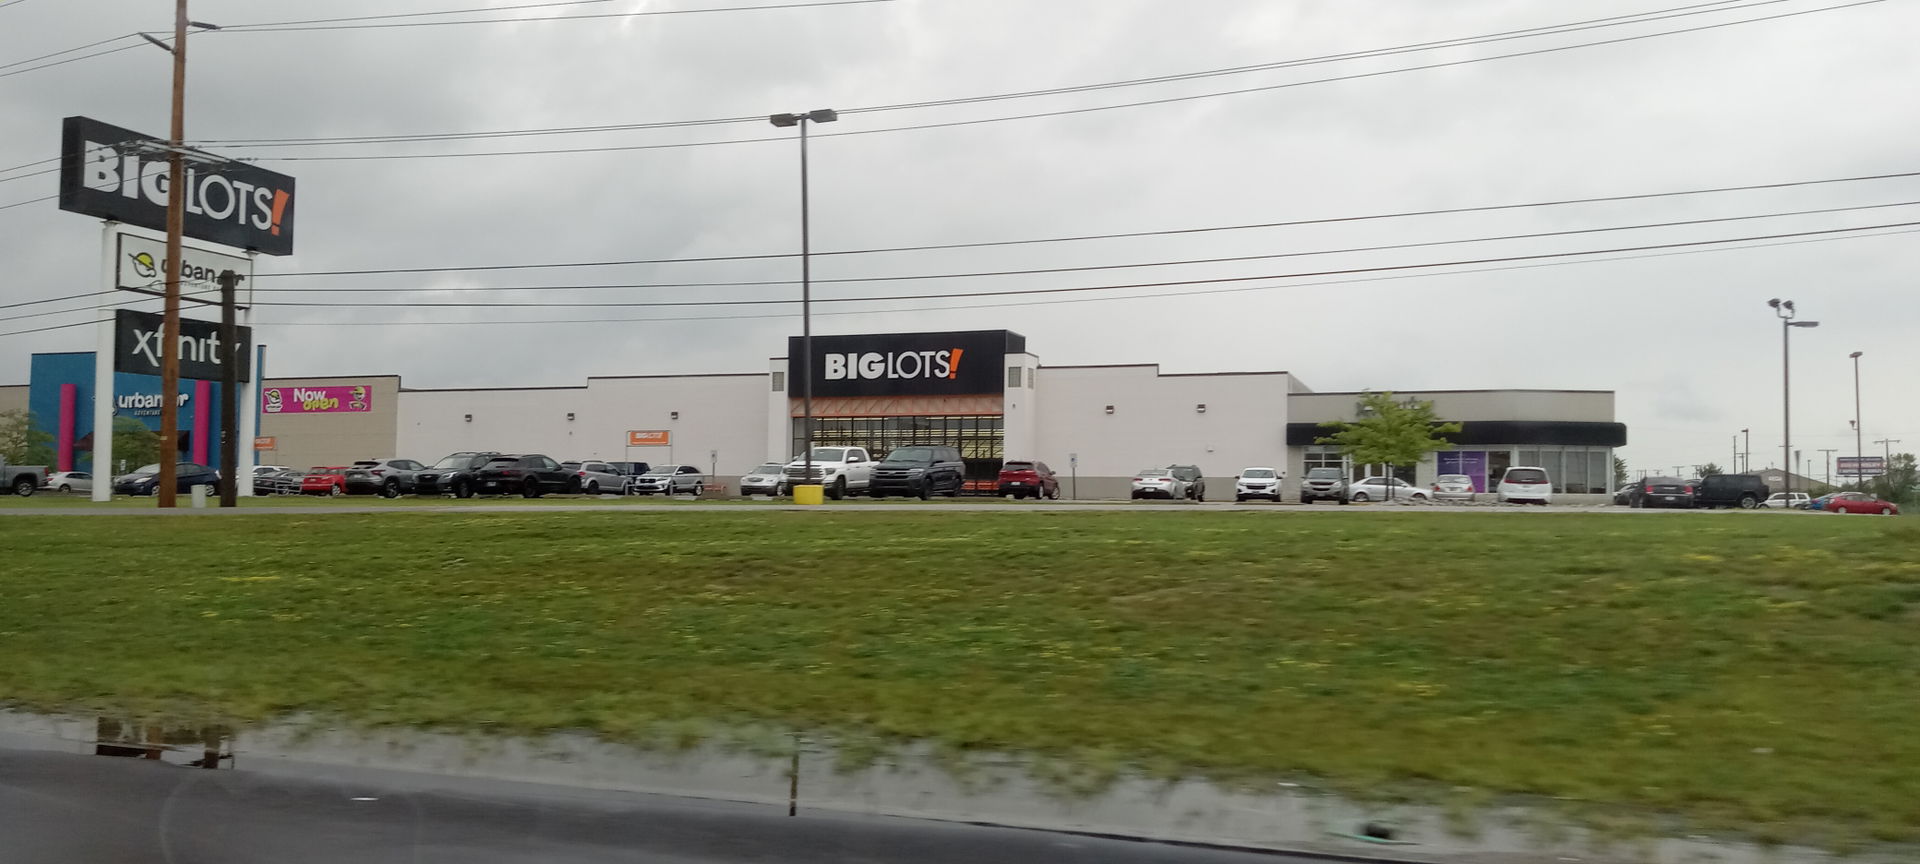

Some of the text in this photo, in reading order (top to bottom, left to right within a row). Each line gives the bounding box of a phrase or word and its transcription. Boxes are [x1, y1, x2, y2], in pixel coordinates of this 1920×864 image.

[131, 322, 242, 368] xfnit
[293, 388, 327, 403] Now
[303, 397, 339, 411] open
